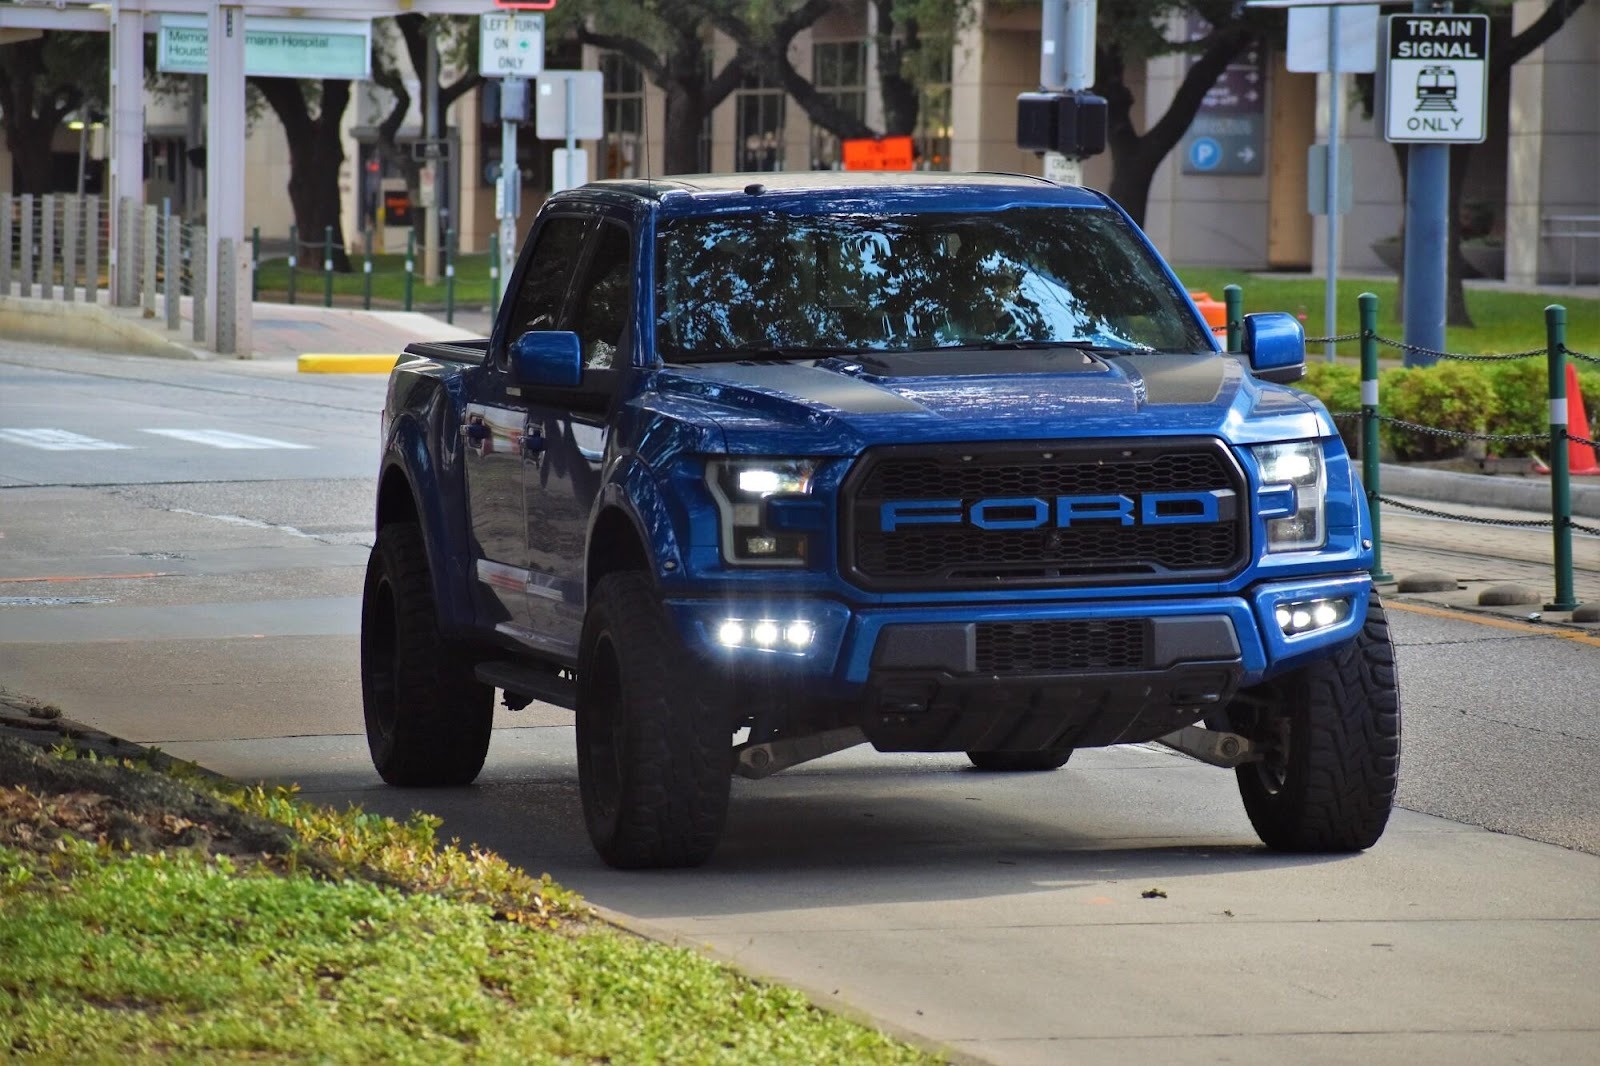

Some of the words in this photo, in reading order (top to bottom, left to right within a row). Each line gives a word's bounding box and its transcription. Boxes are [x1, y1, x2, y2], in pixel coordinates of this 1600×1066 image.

[484, 18, 509, 31] LEFT
[513, 19, 542, 33] TURN
[1406, 20, 1472, 36] TRAIN
[169, 30, 208, 42] Memor
[245, 35, 279, 46] mann
[281, 36, 329, 50] Hospital
[493, 37, 509, 49] ON
[169, 45, 208, 57] Housto
[1398, 41, 1479, 58] SIGNAL
[498, 56, 526, 69] ONLY
[1407, 117, 1464, 132] ONLY
[1198, 144, 1214, 163] P
[880, 490, 1222, 532] FORD
